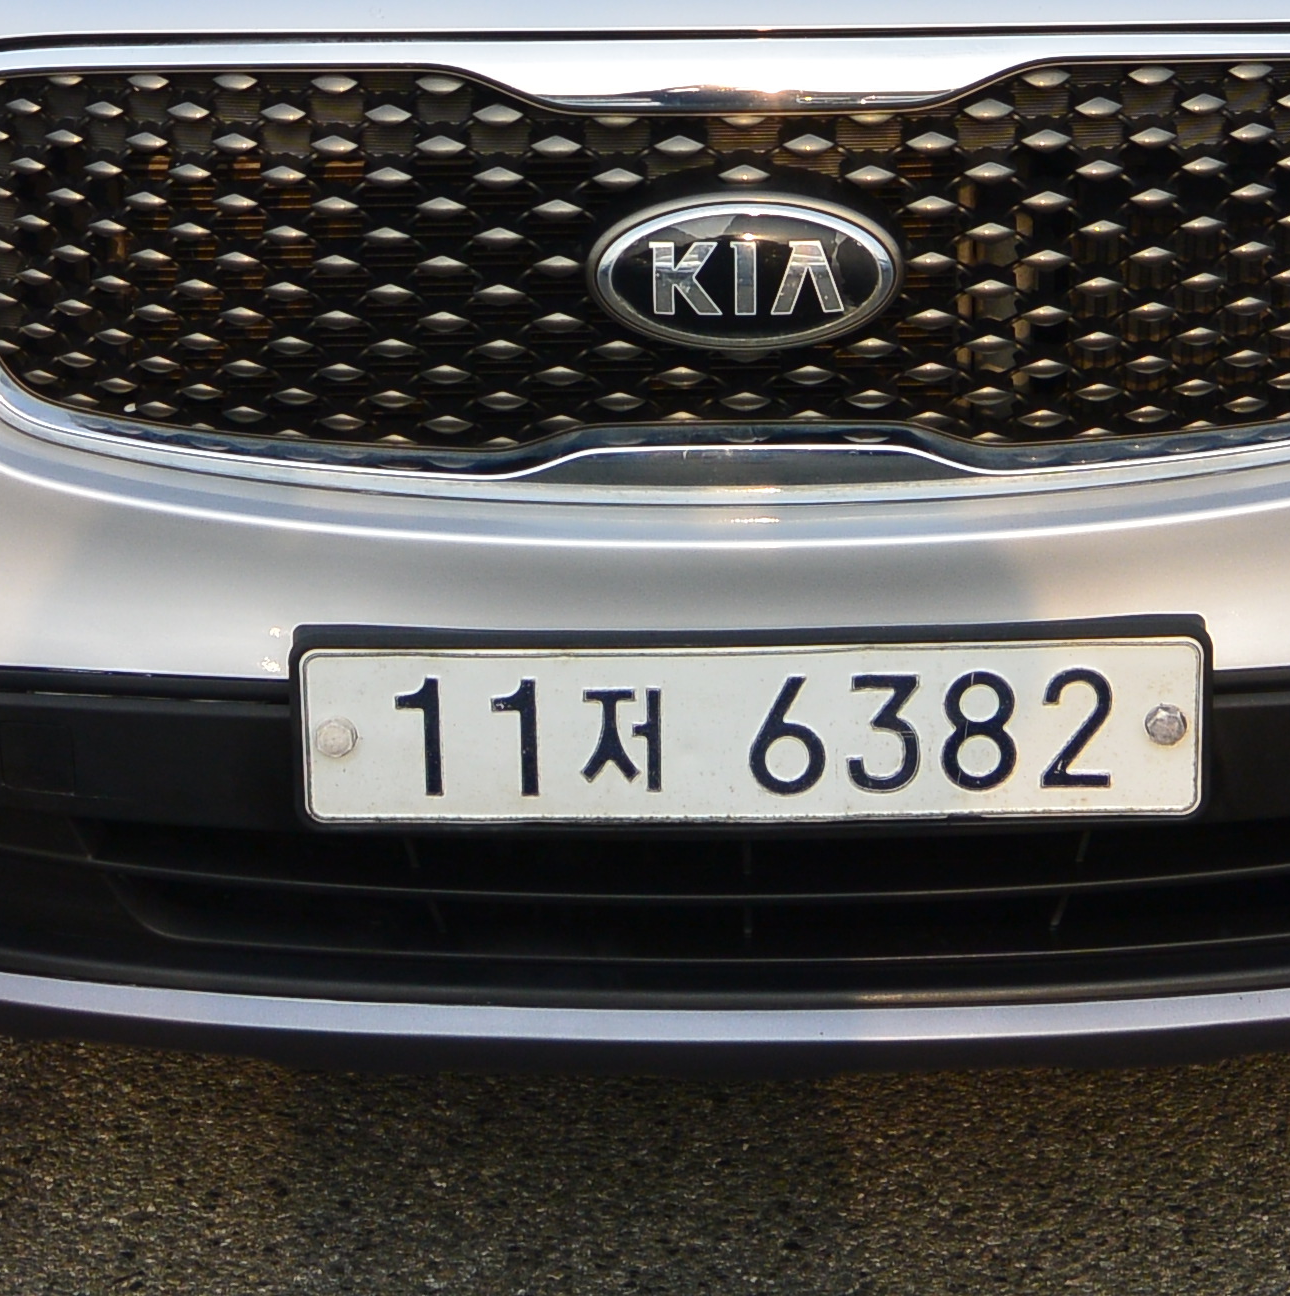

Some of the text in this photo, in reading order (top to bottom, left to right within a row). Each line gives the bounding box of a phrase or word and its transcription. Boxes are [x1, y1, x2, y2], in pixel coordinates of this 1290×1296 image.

[648, 240, 845, 316] KIA
[393, 667, 1113, 798] 11저 6382
